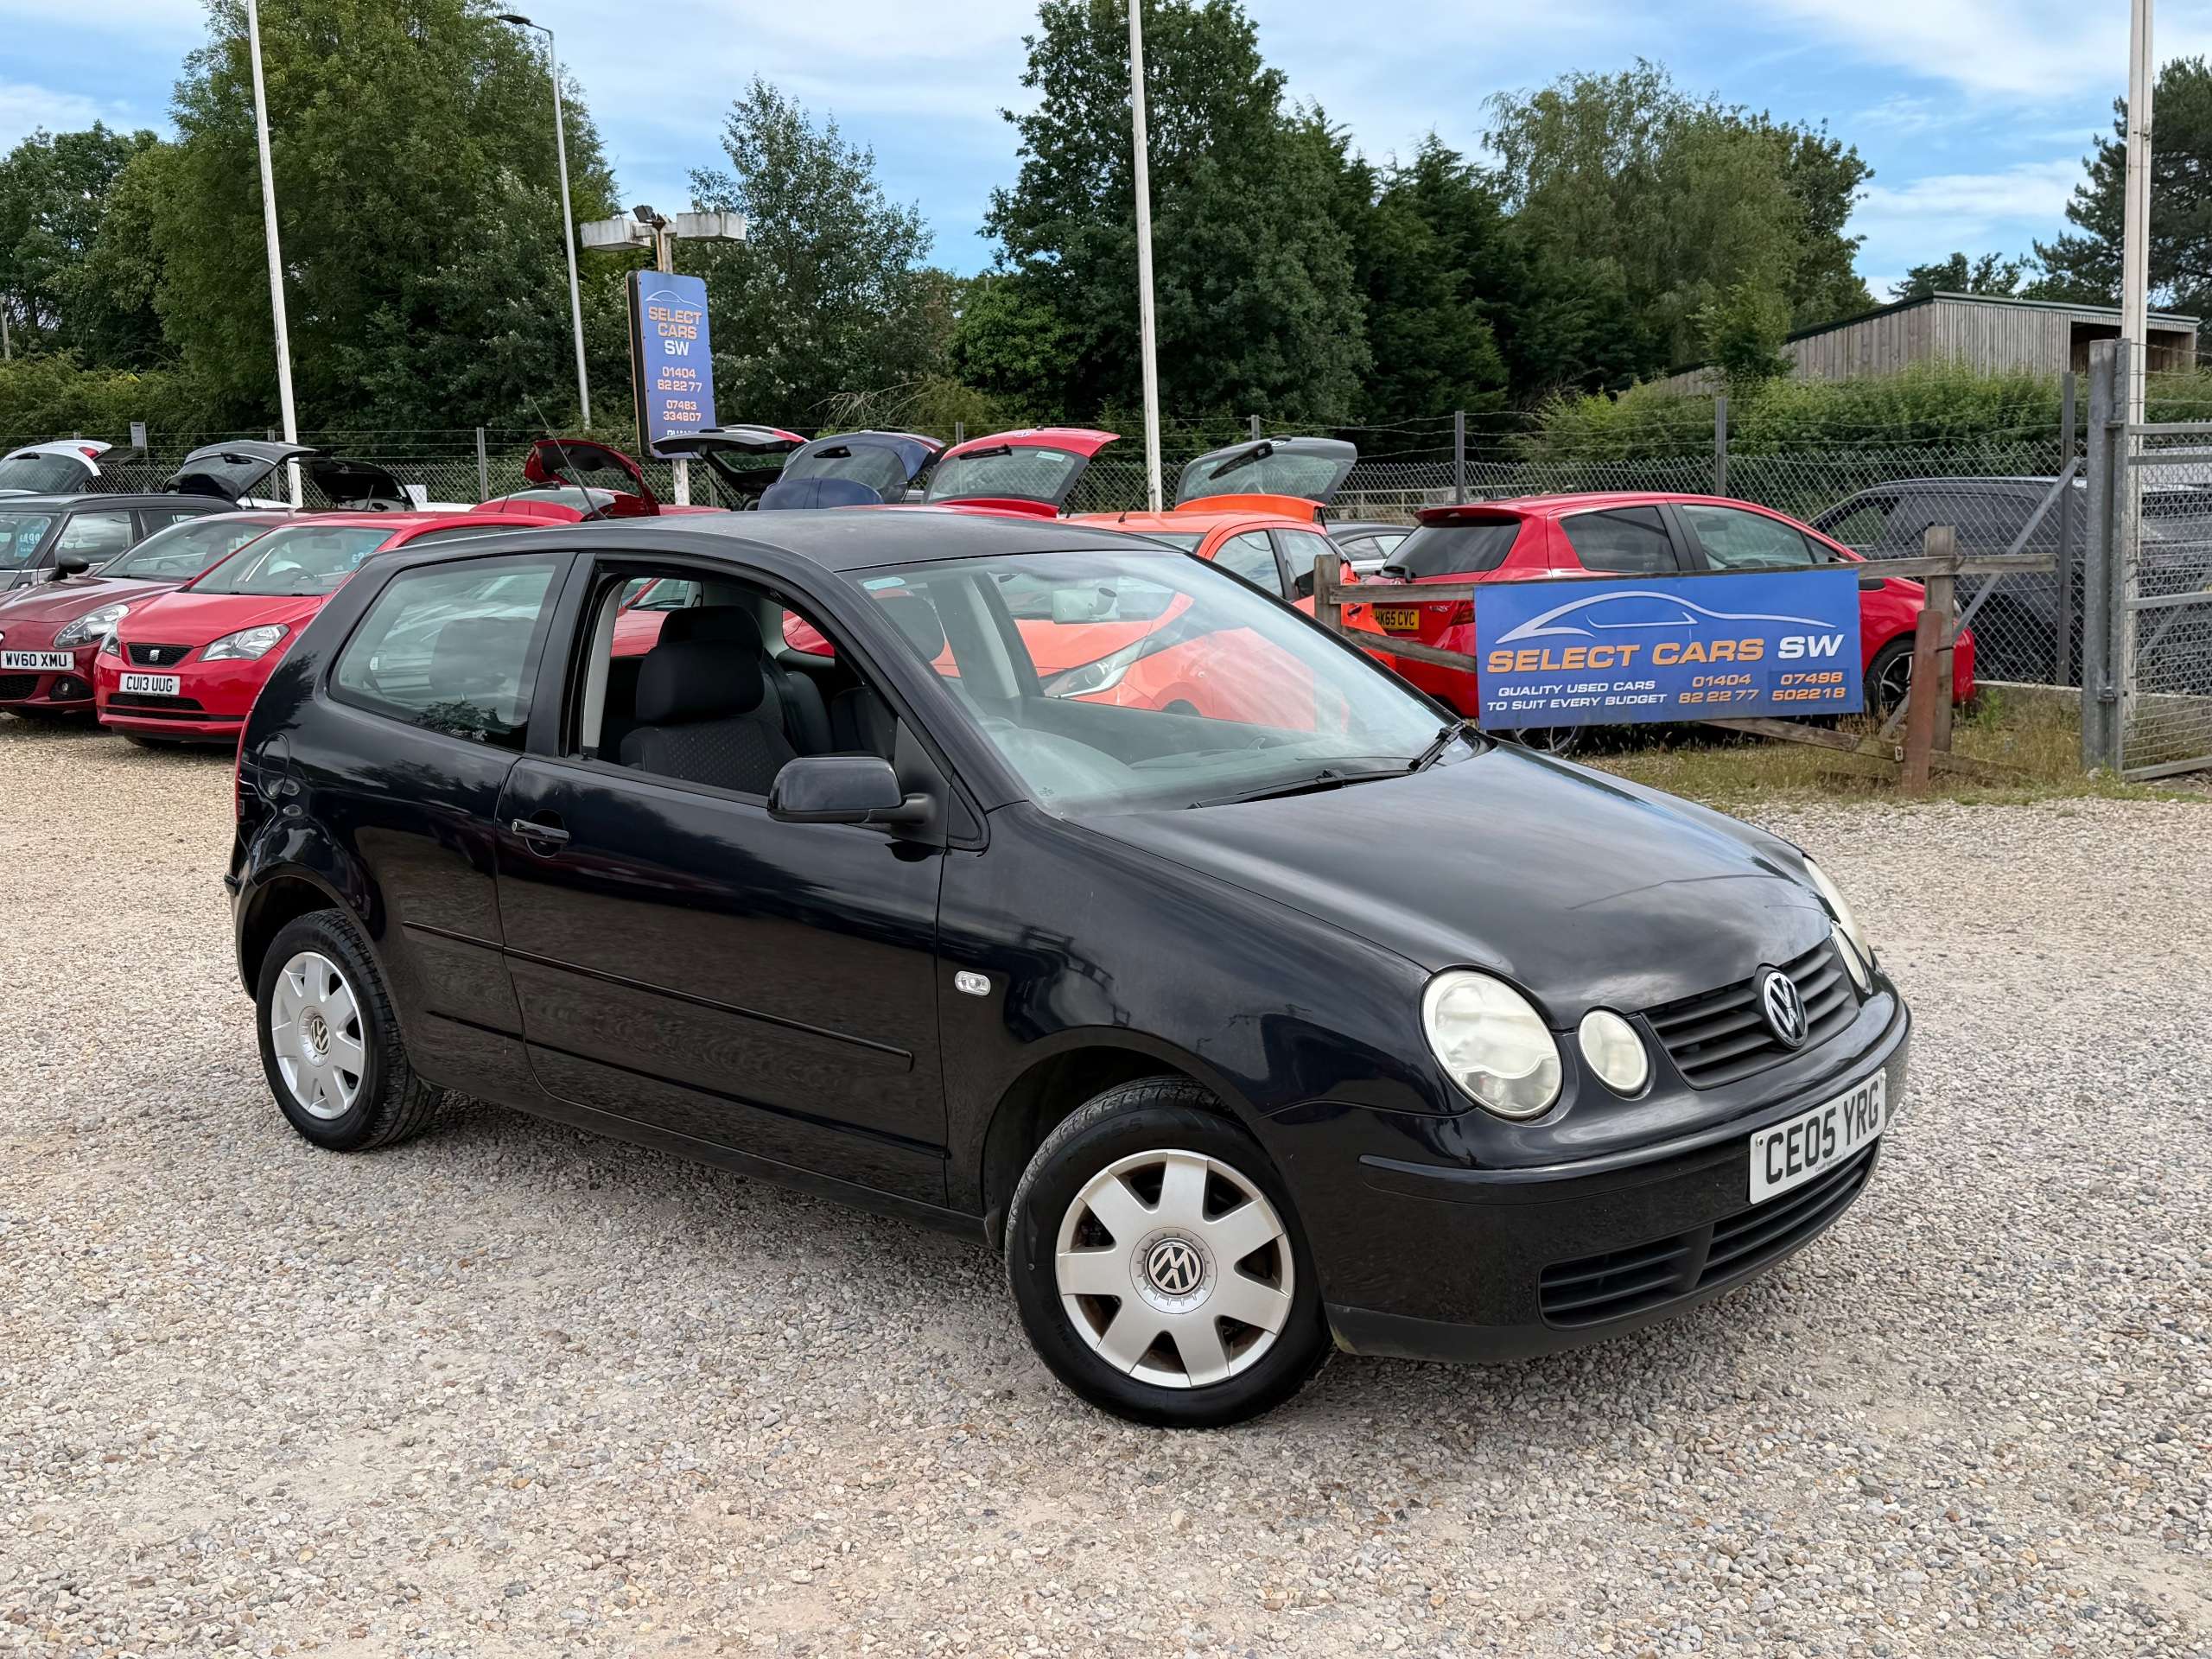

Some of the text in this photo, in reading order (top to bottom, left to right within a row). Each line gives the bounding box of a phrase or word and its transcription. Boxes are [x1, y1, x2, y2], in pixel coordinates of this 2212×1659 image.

[649, 306, 702, 325] SELECT
[658, 322, 697, 340] CARS
[664, 340, 690, 356] SW
[662, 366, 696, 378] 01404
[666, 399, 697, 410] 07483
[663, 410, 702, 422] 334807
[6, 653, 67, 667] WV60 XMU
[1486, 634, 1845, 673] SELECT CARS SW
[126, 676, 174, 692] CU13 UUG
[1692, 674, 1751, 688] 01404
[1780, 671, 1843, 685] 07498
[1498, 680, 1656, 697] QUALITY USED CARS
[1771, 687, 1847, 702] 502218
[1487, 694, 1668, 711] TO SUIT EVERY BUDGET
[1765, 1080, 1878, 1185] CE05 YRG
